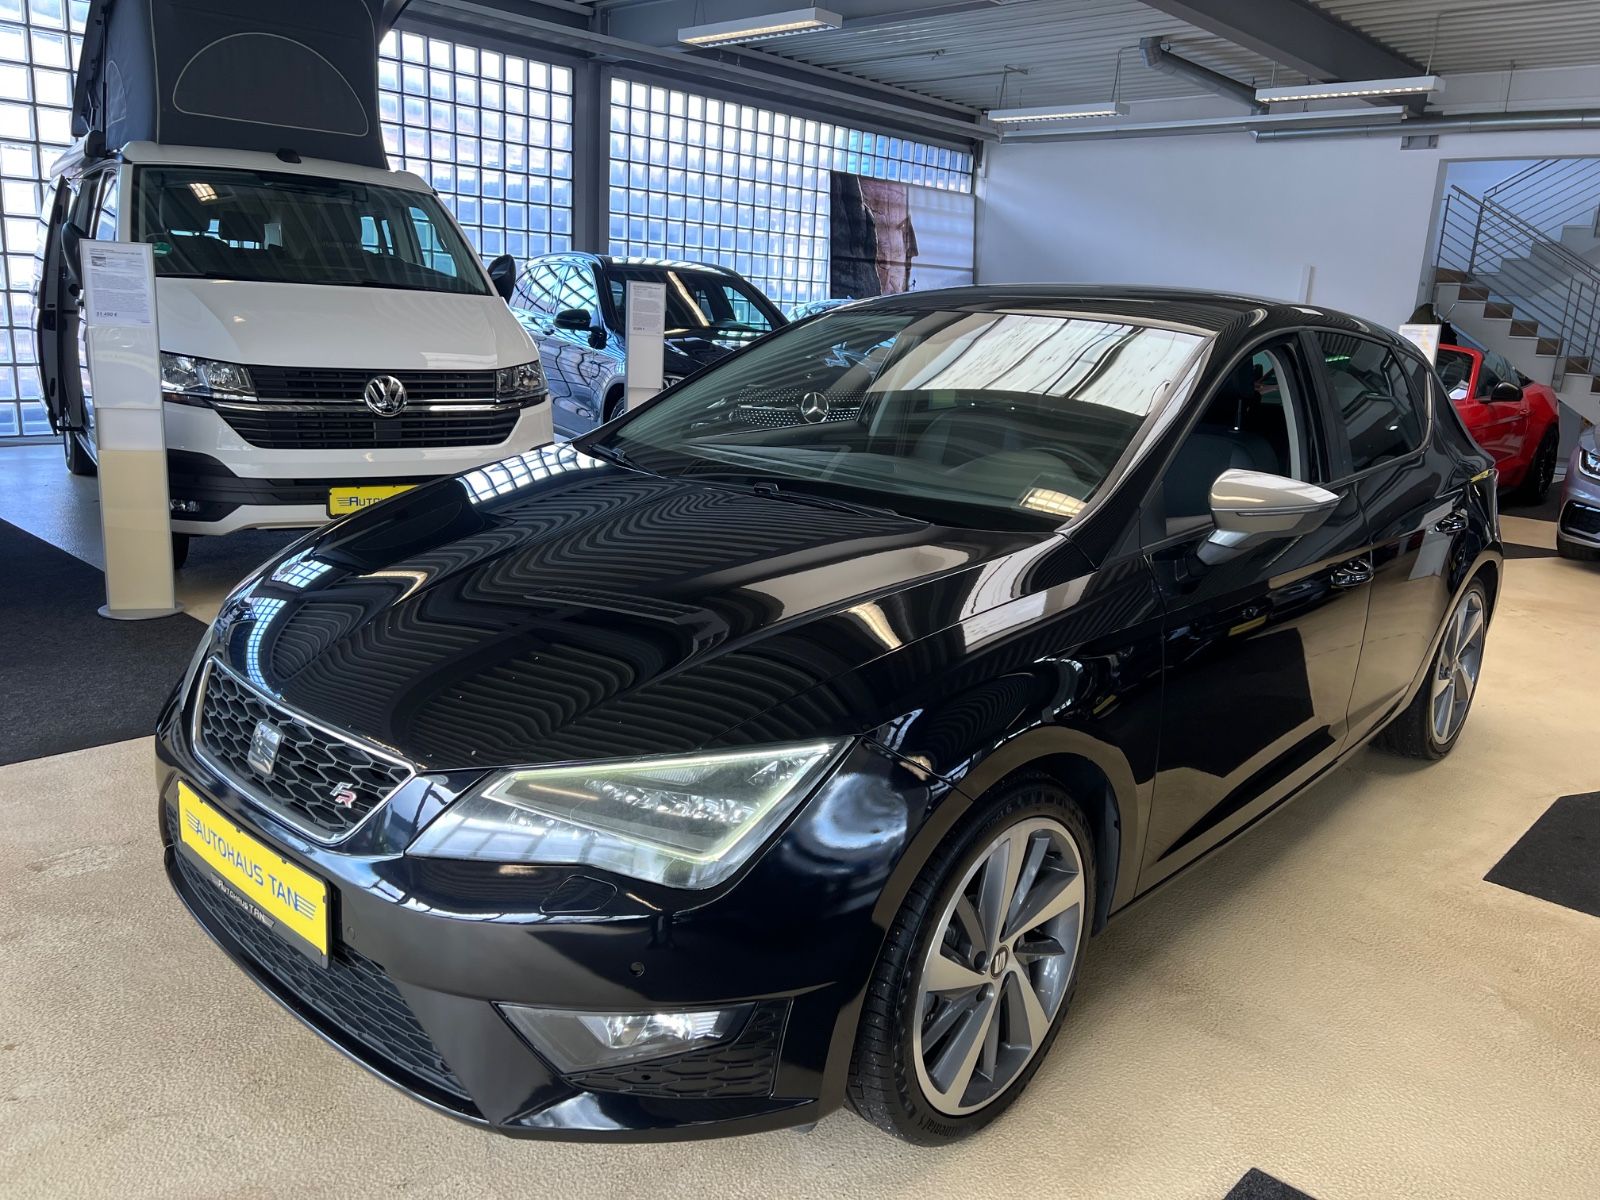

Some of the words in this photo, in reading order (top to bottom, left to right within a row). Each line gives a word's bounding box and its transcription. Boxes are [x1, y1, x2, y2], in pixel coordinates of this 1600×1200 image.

[330, 781, 357, 808] FR
[196, 819, 265, 887] AUTOHAUS
[268, 873, 301, 912] TAN
